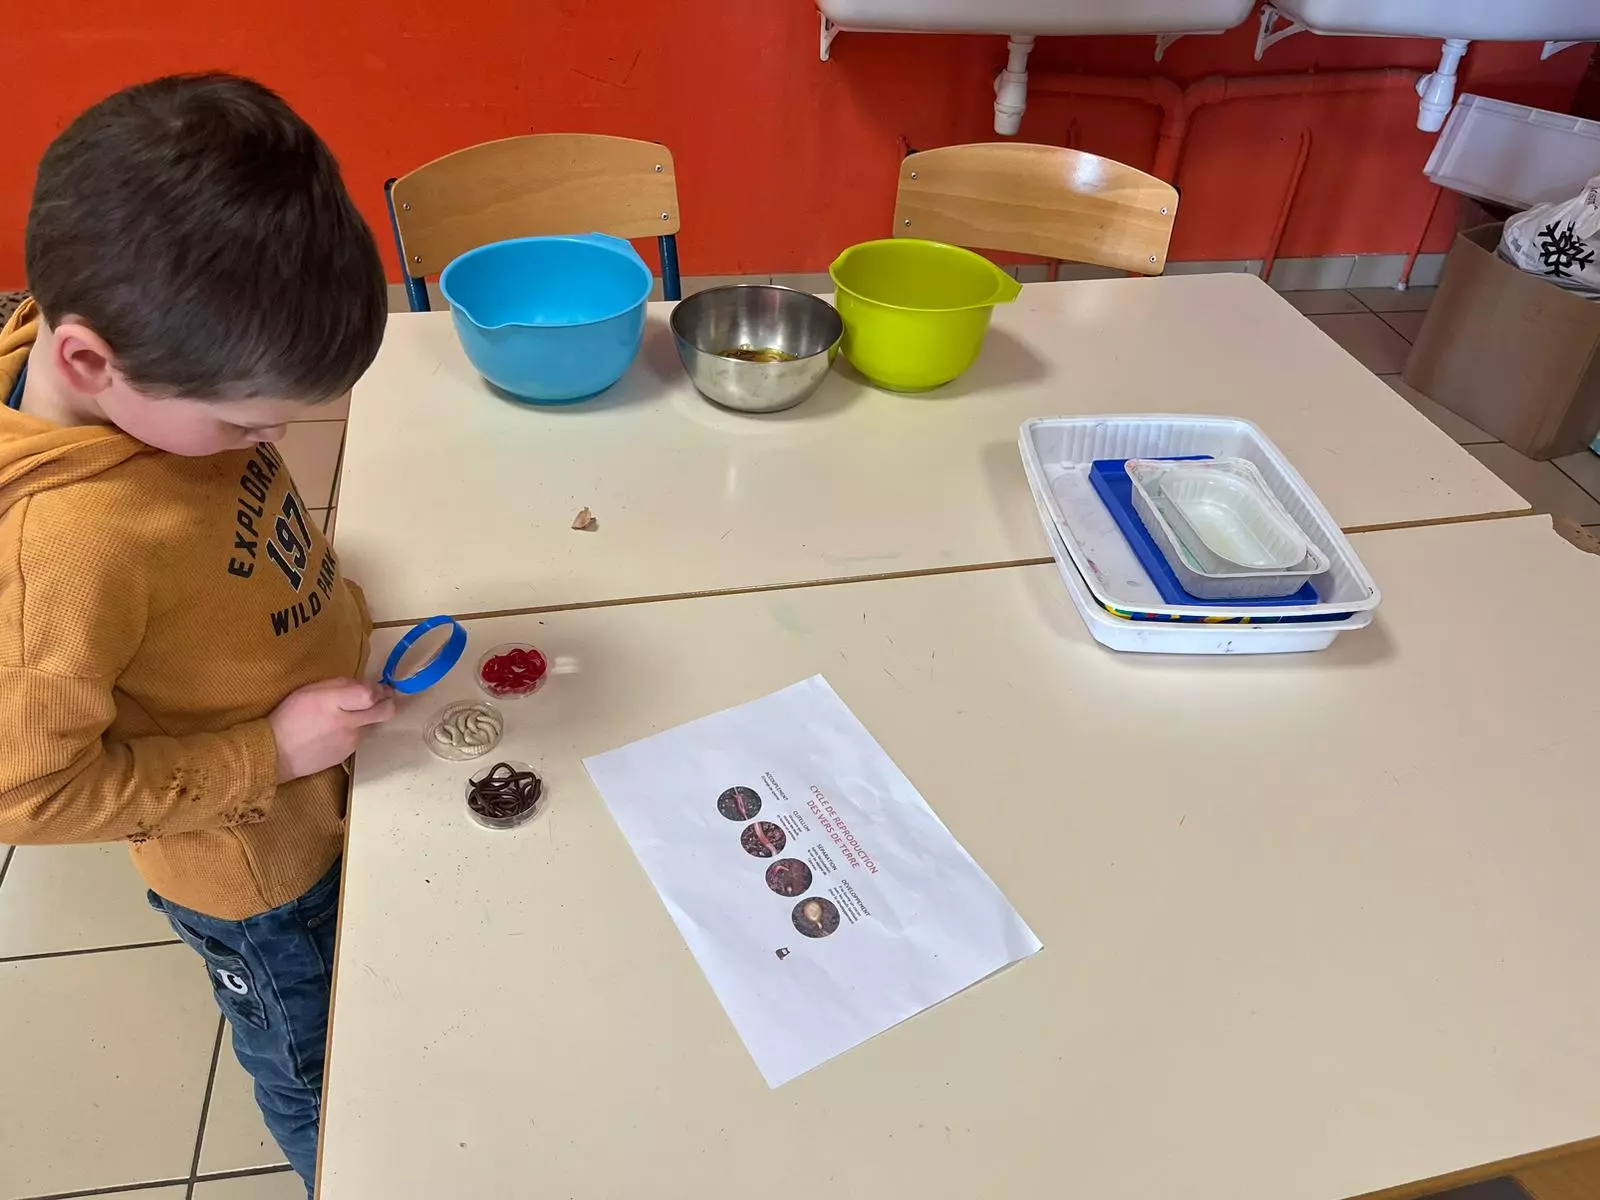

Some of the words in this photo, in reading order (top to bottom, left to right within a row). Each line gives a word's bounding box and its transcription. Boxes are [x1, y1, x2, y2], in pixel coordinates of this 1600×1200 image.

[266, 490, 313, 593] 197
[270, 591, 322, 637] WILD
[317, 547, 338, 600] PARK
[807, 800, 821, 815] DES
[818, 814, 835, 833] VERS
[831, 833, 842, 844] DE
[840, 844, 859, 869] TERRE
[810, 785, 829, 806] CYCLE
[825, 805, 837, 817] DE
[833, 816, 878, 874] REPRODUCTION
